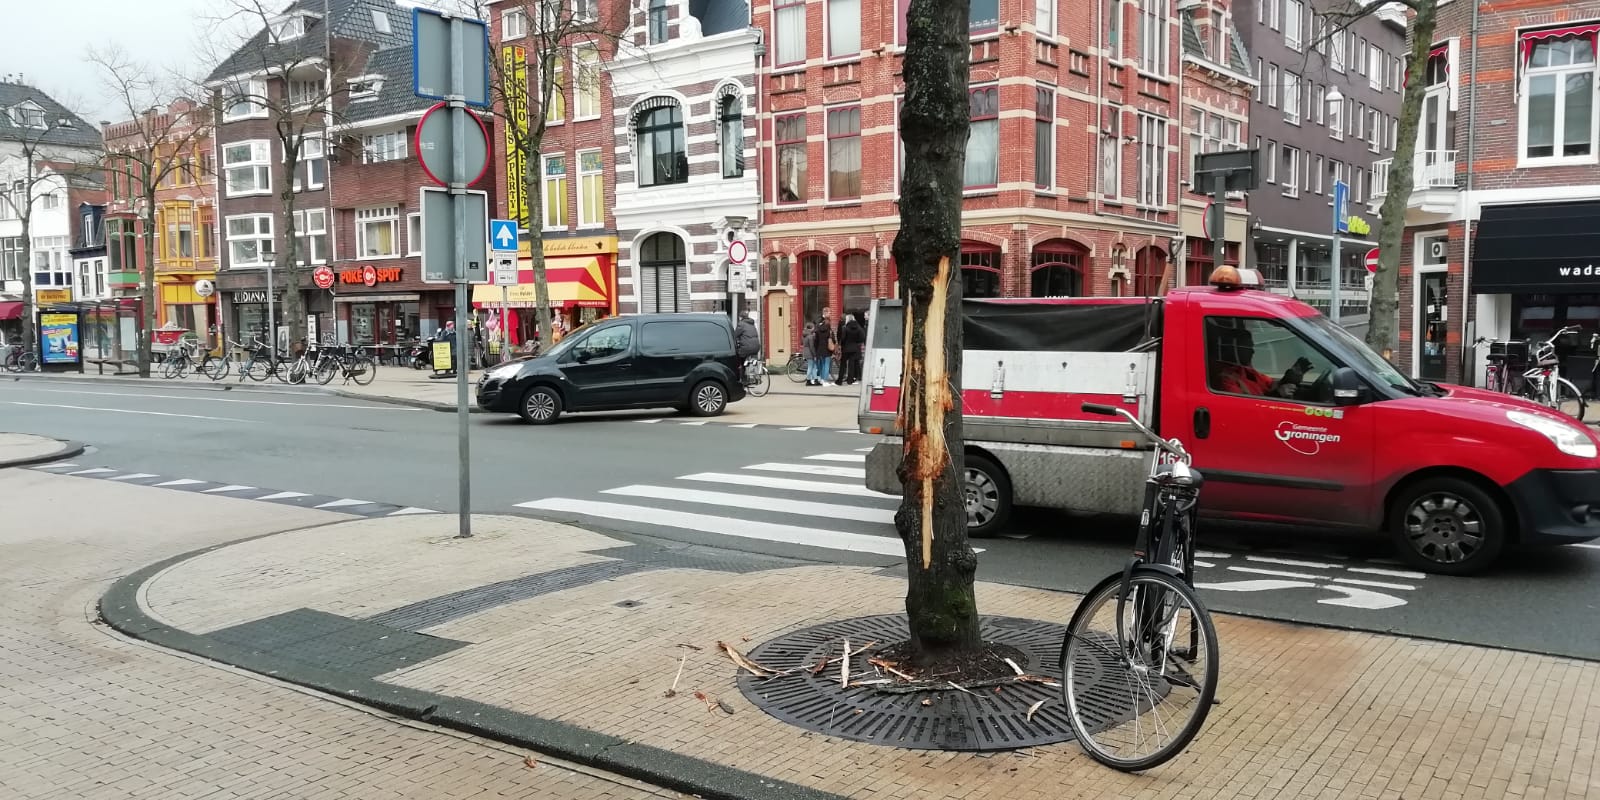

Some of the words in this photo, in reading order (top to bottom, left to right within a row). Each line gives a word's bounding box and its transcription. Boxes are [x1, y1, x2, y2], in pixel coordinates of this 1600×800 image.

[508, 163, 516, 208] PARTY
[377, 268, 401, 282] SPOT
[1292, 424, 1328, 433] Gemeente
[1274, 429, 1340, 443] Groningen
